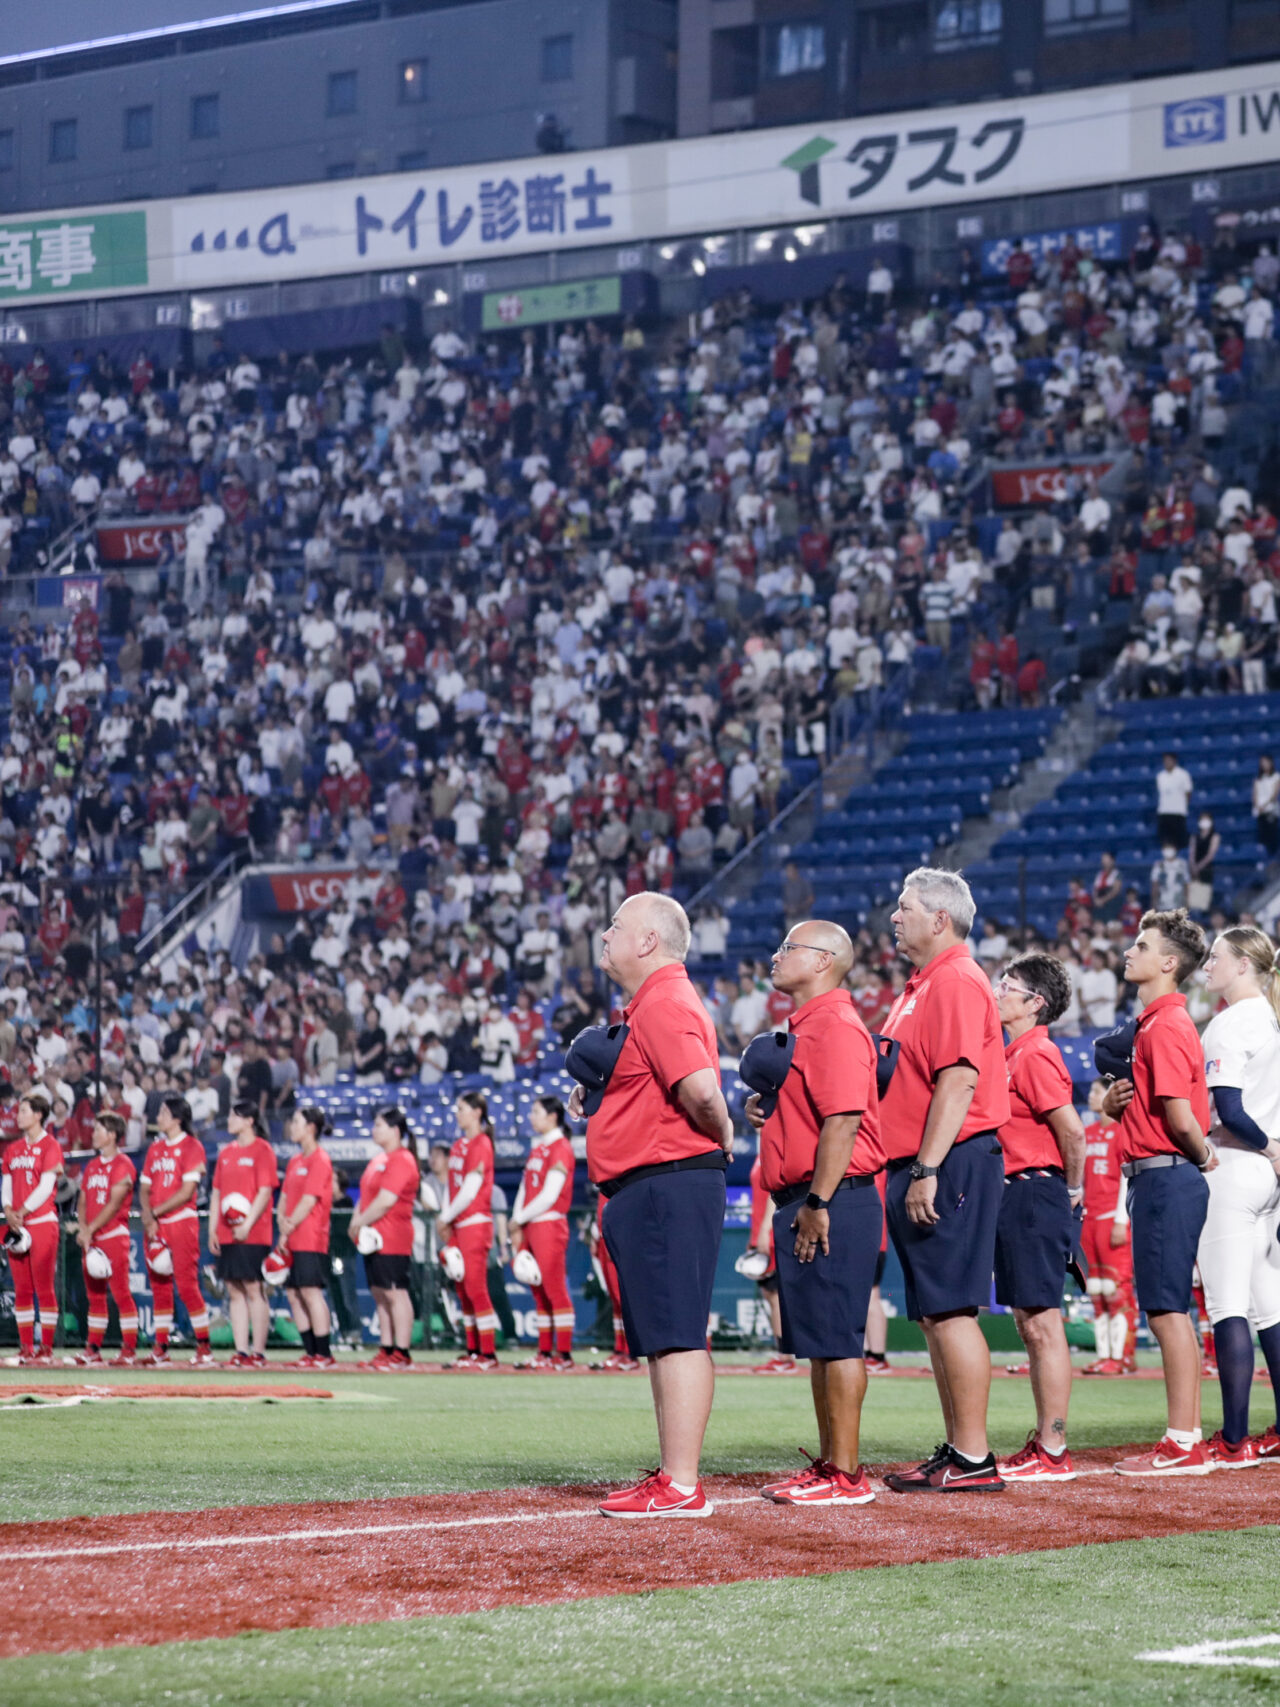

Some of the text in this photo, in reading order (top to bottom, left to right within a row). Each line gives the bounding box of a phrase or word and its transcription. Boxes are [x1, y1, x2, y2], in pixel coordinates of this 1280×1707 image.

[846, 118, 1024, 199] タスク
[1173, 112, 1216, 134] EYE
[356, 167, 612, 256] トイレ診断士
